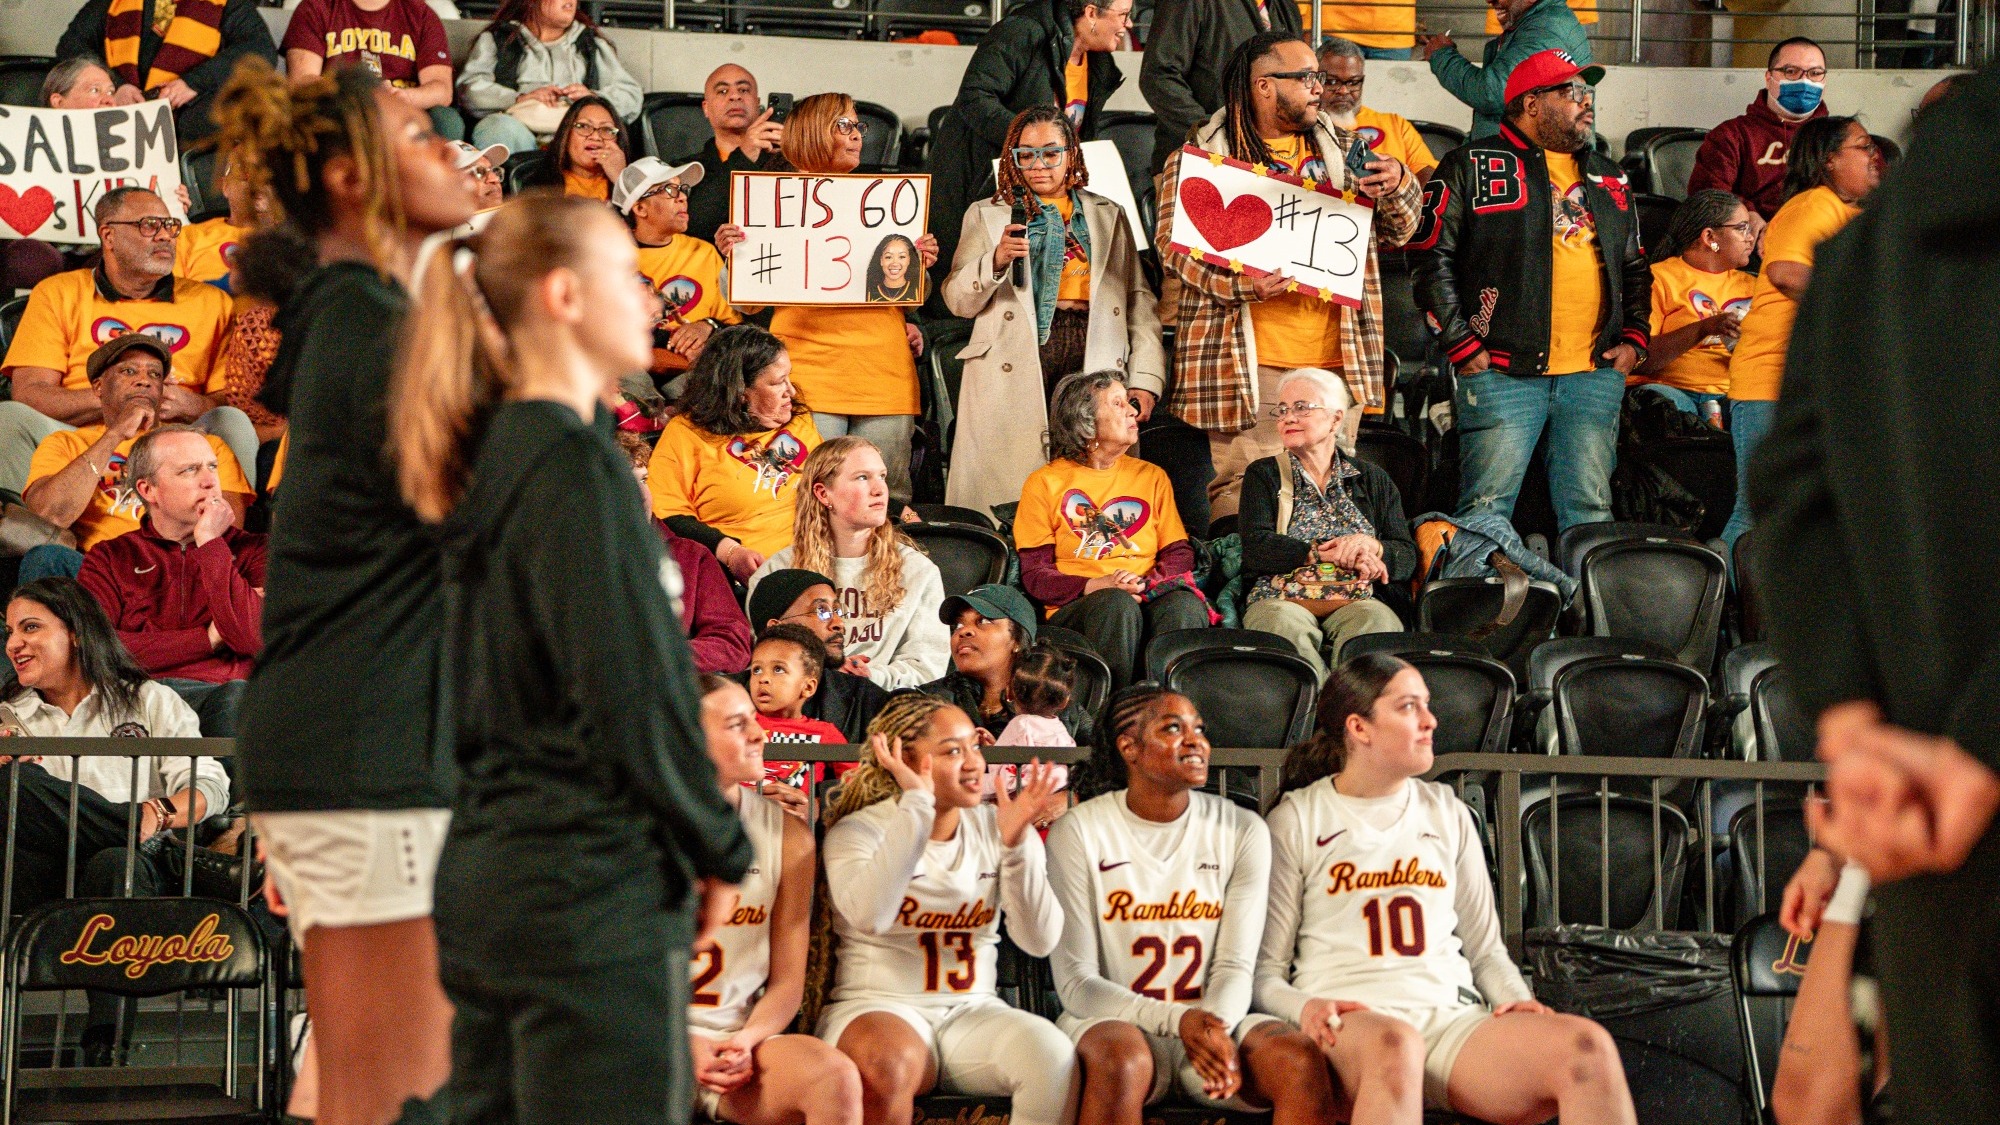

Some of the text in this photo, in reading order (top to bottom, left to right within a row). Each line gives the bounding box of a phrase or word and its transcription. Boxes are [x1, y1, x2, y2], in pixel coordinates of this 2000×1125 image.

[325, 27, 417, 62] LOYOLA
[0, 104, 175, 175] SALEM
[859, 178, 919, 228] GO
[1469, 149, 1528, 215] B
[804, 235, 852, 291] 13
[1274, 193, 1359, 277] #13
[1469, 286, 1499, 338] Bulls
[1103, 888, 1223, 922] Ramblers
[1326, 855, 1446, 896] Ramblers
[60, 913, 235, 979] Loyola
[1362, 895, 1427, 958] 10
[918, 930, 976, 993] 13
[1130, 934, 1203, 1002] 22
